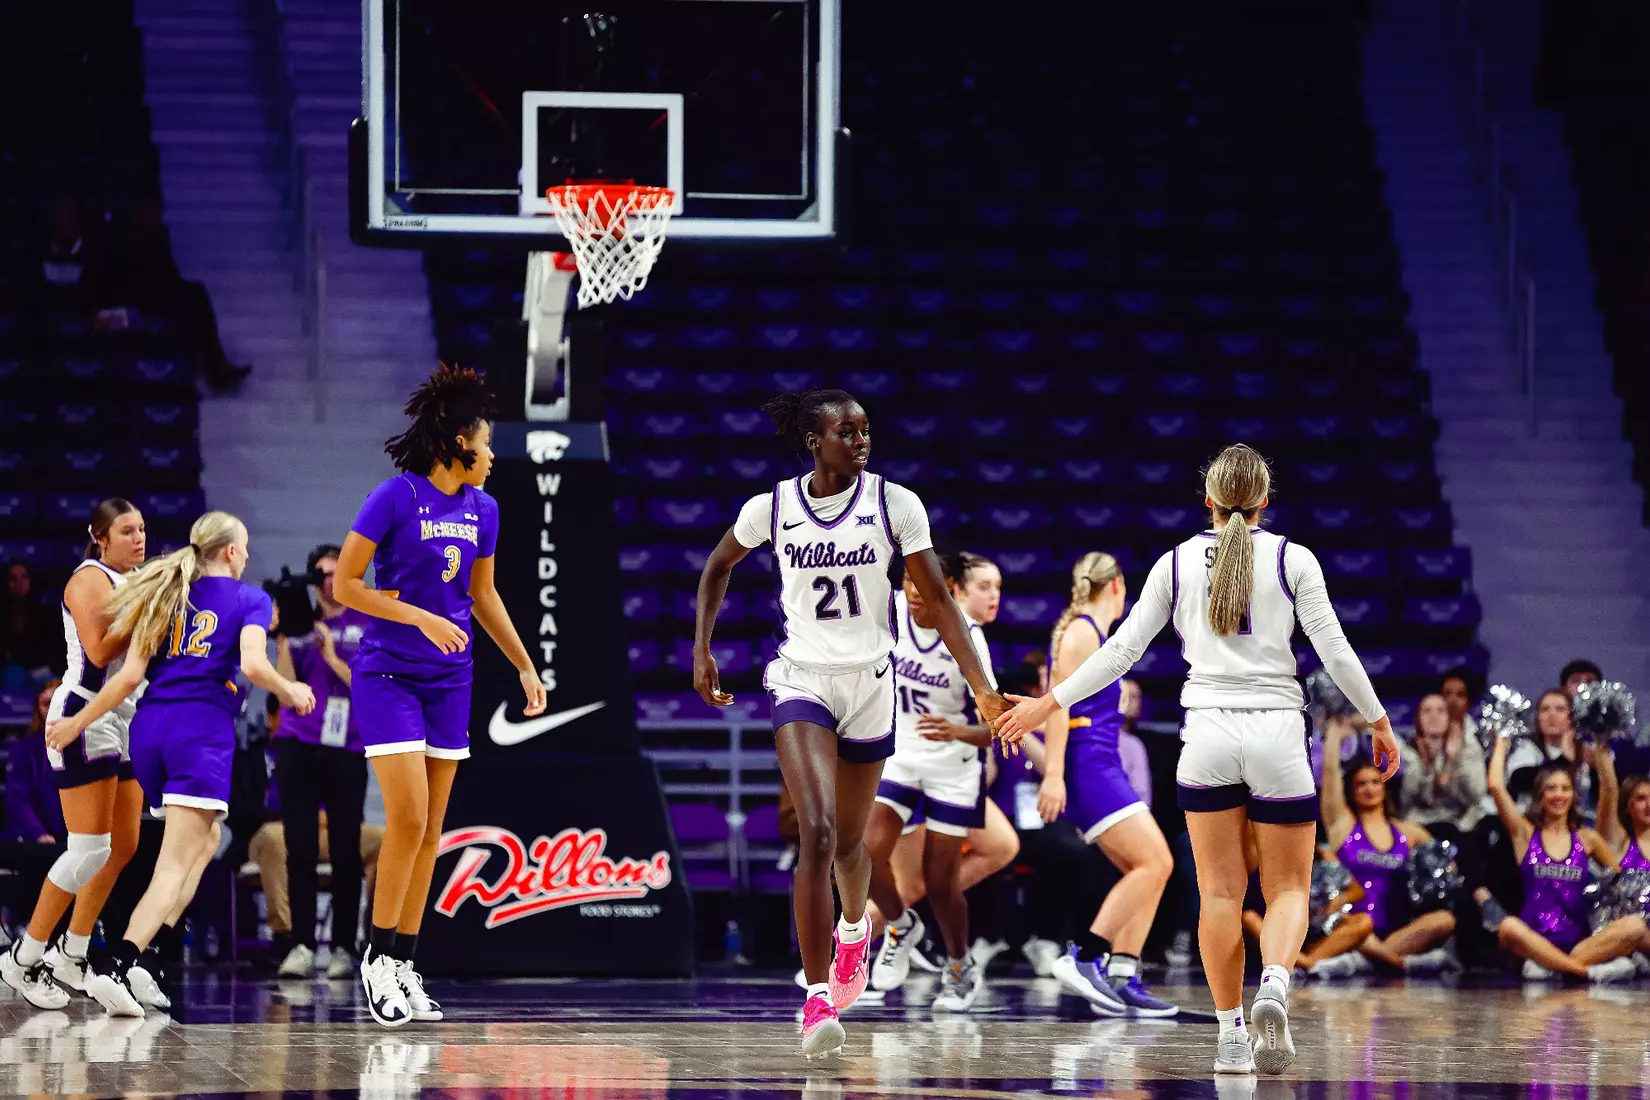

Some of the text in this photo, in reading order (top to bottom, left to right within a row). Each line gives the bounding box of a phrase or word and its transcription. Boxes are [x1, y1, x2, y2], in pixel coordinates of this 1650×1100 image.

[442, 545, 461, 582] 3
[784, 541, 877, 568] Wildcats
[536, 473, 561, 692] WILDCATS
[811, 574, 861, 621] 21
[167, 609, 218, 659] 12
[898, 685, 930, 714] 15
[434, 825, 672, 918] Dillons
